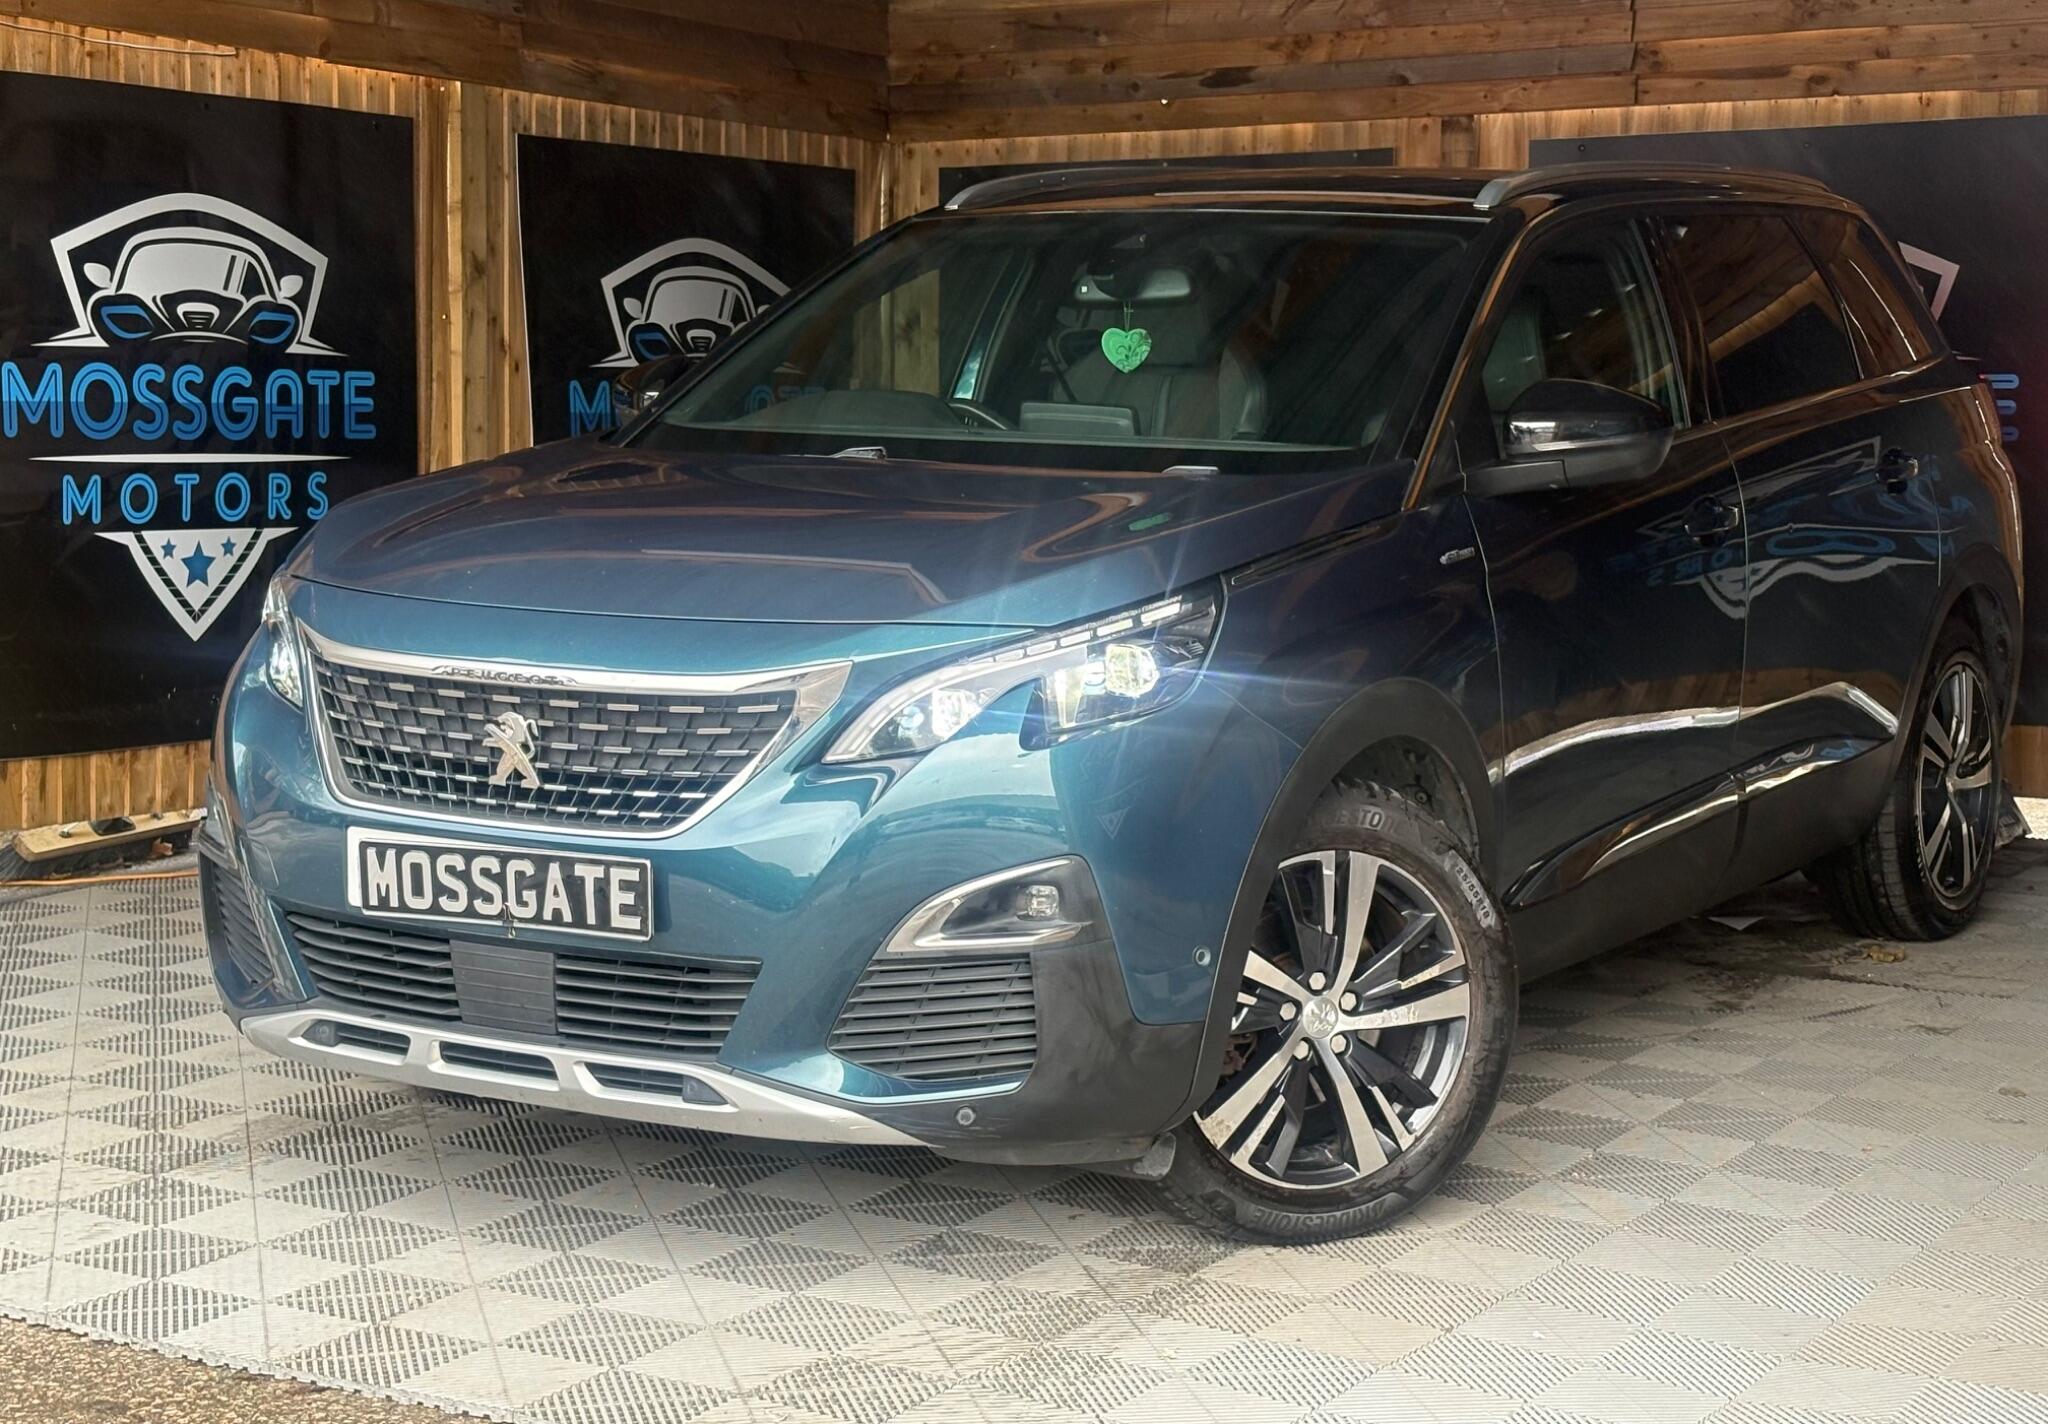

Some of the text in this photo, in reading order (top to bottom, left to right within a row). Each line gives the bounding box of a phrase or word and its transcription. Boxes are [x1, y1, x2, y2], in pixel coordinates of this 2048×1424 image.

[1, 361, 377, 441] MOSSGATE
[62, 471, 329, 525] MOTORS
[450, 667, 558, 686] PEUGEOT
[366, 846, 641, 930] MOSSGATE
